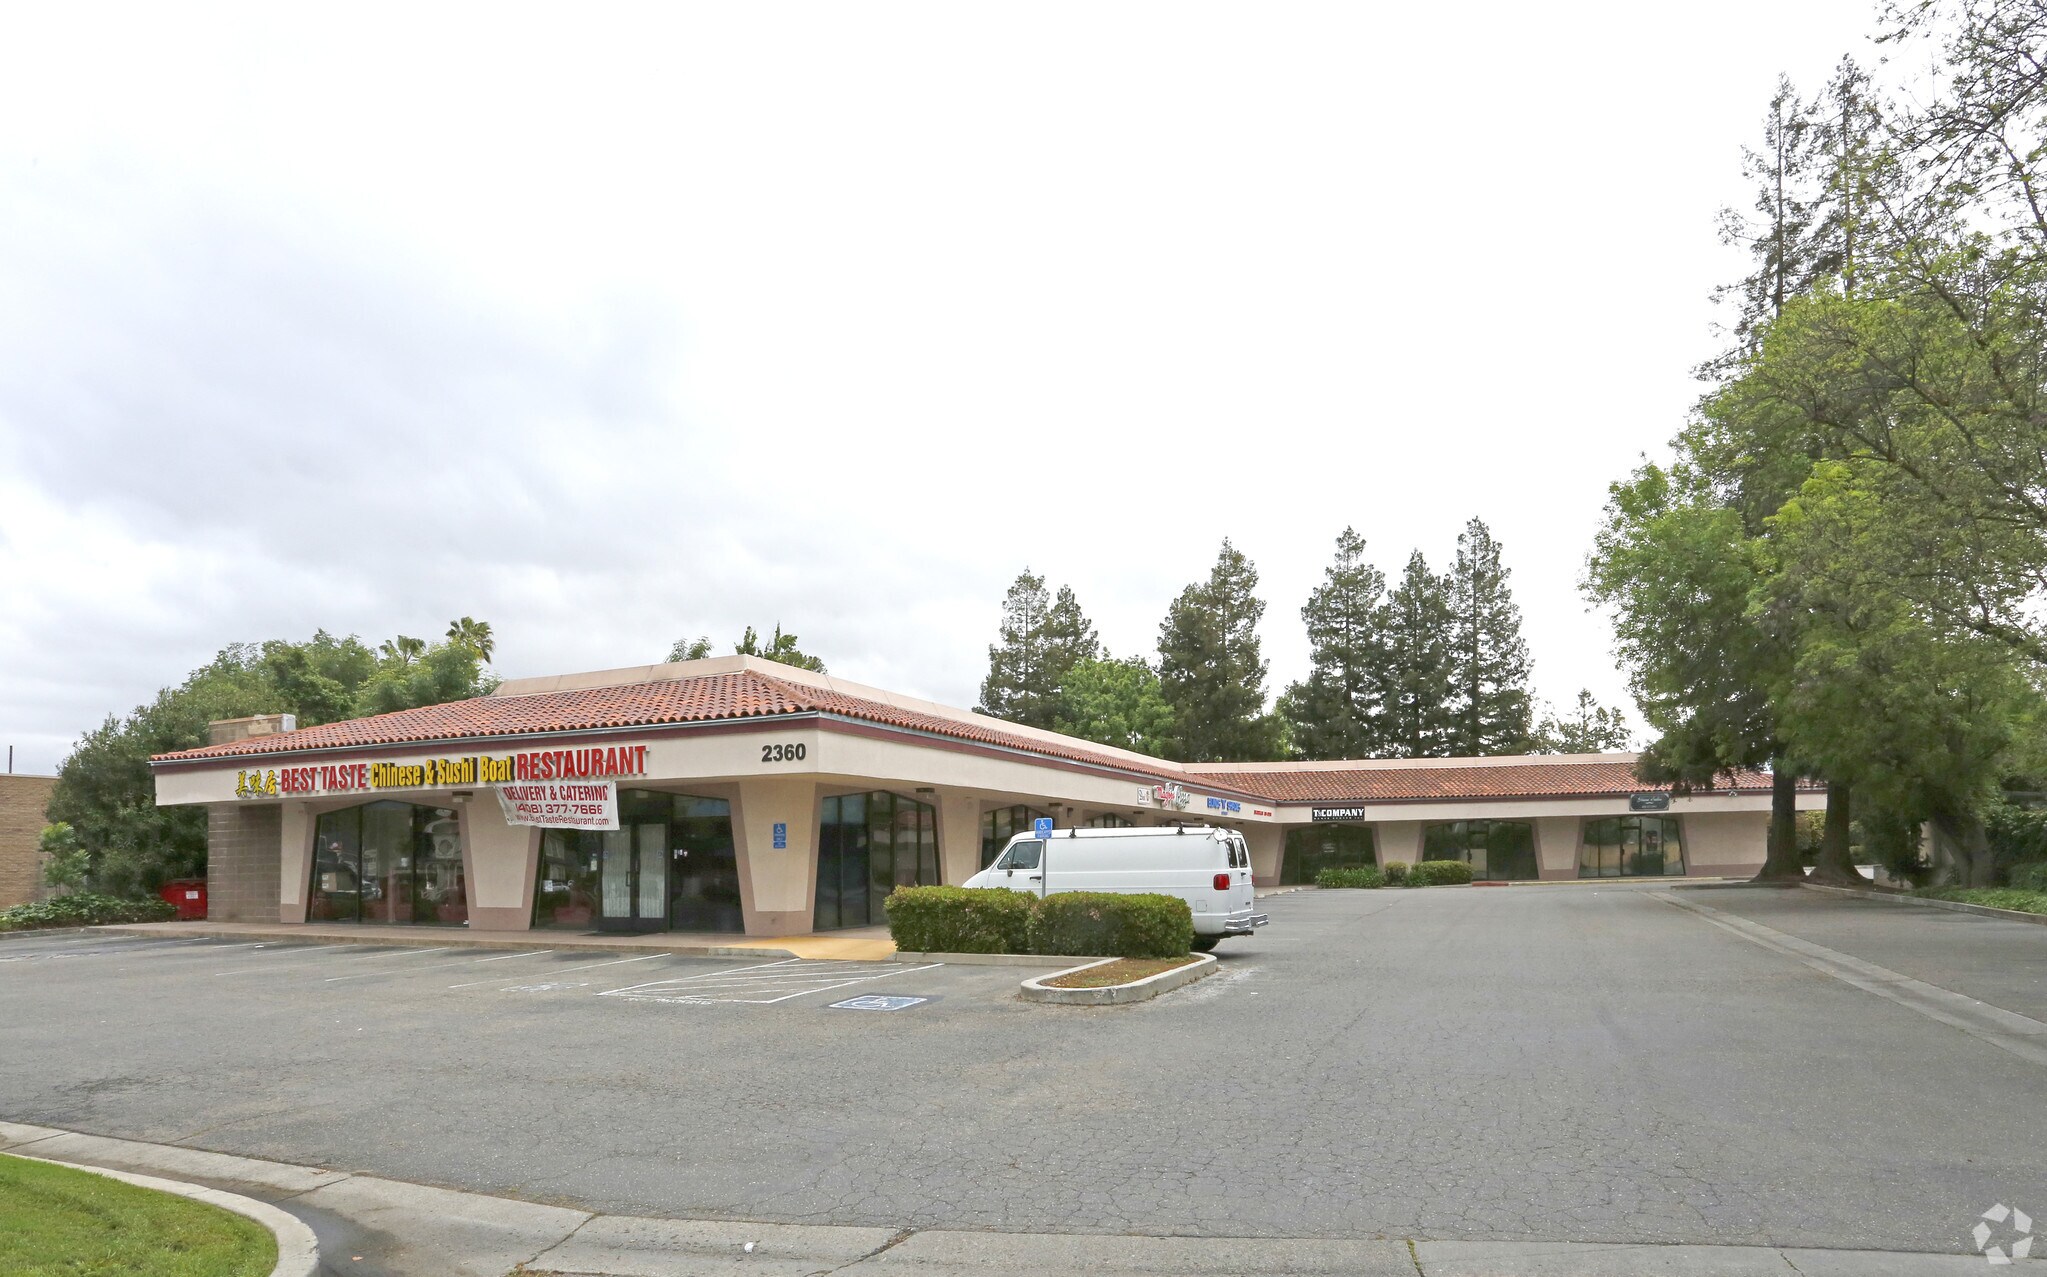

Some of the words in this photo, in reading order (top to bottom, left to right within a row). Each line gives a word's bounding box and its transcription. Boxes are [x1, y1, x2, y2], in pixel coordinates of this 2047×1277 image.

[762, 743, 806, 762] 2360
[281, 767, 318, 792] BEST
[321, 763, 367, 790] TASTE
[370, 762, 421, 788] Chinese
[424, 759, 435, 785] &
[437, 757, 475, 784] Sushi
[480, 755, 512, 782] Boat
[517, 745, 647, 781] RESTAURANT
[503, 785, 547, 801] DELIVERY
[549, 785, 557, 801] &
[545, 804, 602, 815] 377-7666
